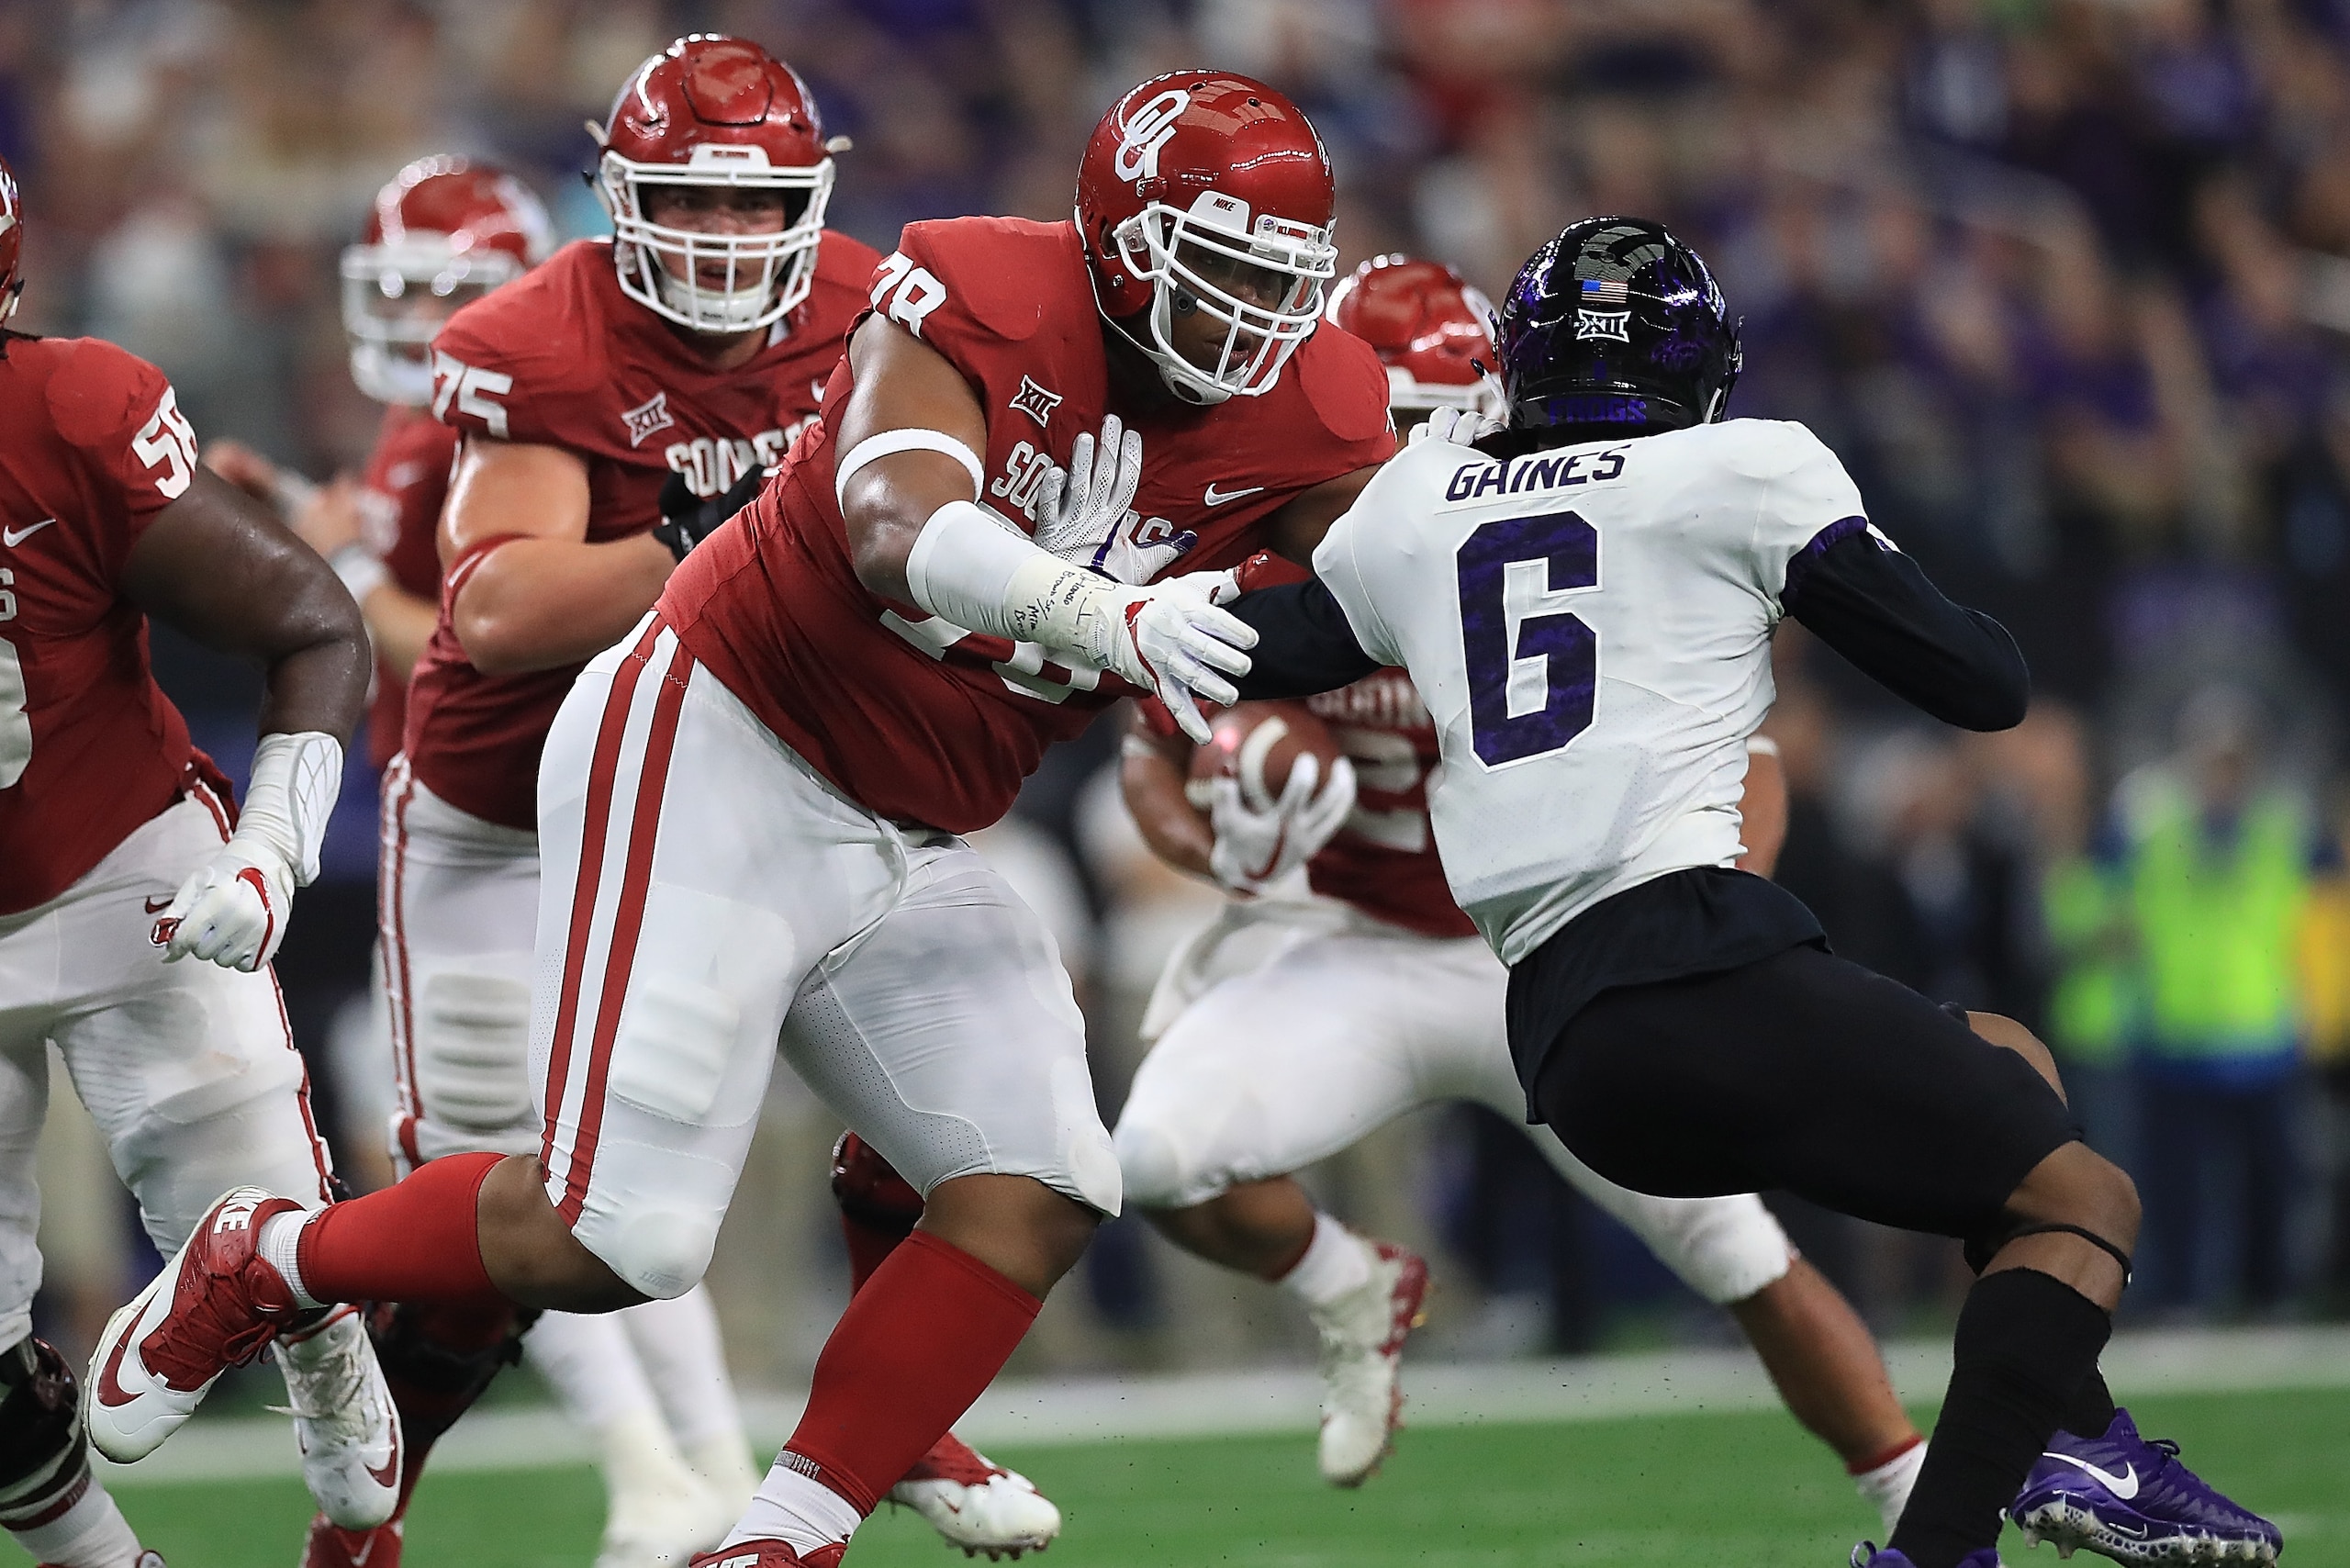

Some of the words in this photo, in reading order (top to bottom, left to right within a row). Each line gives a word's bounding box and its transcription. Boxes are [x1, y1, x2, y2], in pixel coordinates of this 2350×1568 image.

[1212, 197, 1237, 212] NIKE
[868, 250, 947, 340] 78
[431, 349, 514, 440] 75
[1549, 396, 1648, 426] FROGS
[1445, 443, 1632, 502] GAINES
[1455, 510, 1600, 772] 6
